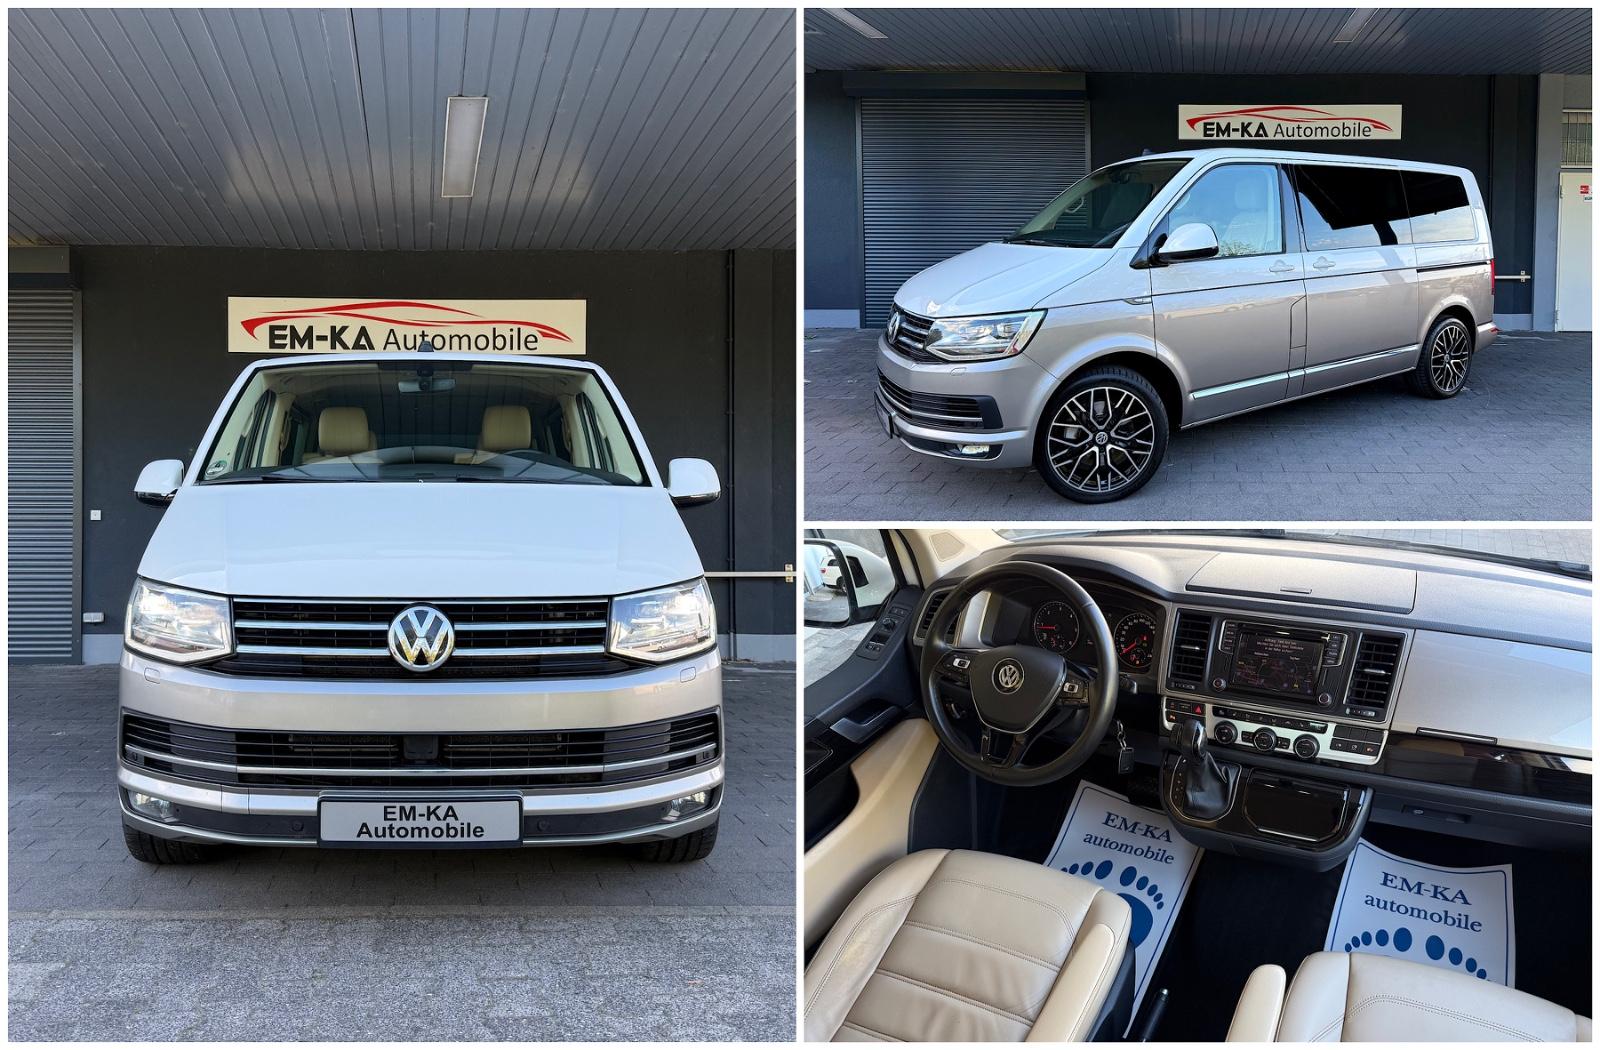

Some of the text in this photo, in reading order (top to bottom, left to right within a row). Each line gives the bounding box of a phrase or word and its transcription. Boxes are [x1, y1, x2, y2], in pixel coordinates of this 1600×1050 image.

[1203, 121, 1372, 138] EM-KA Automobile
[268, 325, 539, 352] EM-KA Automobile
[391, 607, 453, 668] VW
[383, 805, 459, 822] EM-KA
[1102, 811, 1173, 843] EM-KA
[356, 822, 485, 839] Automobile
[1083, 832, 1175, 865] automobile
[1380, 871, 1472, 906] EM-KA
[1364, 894, 1483, 933] automobile
